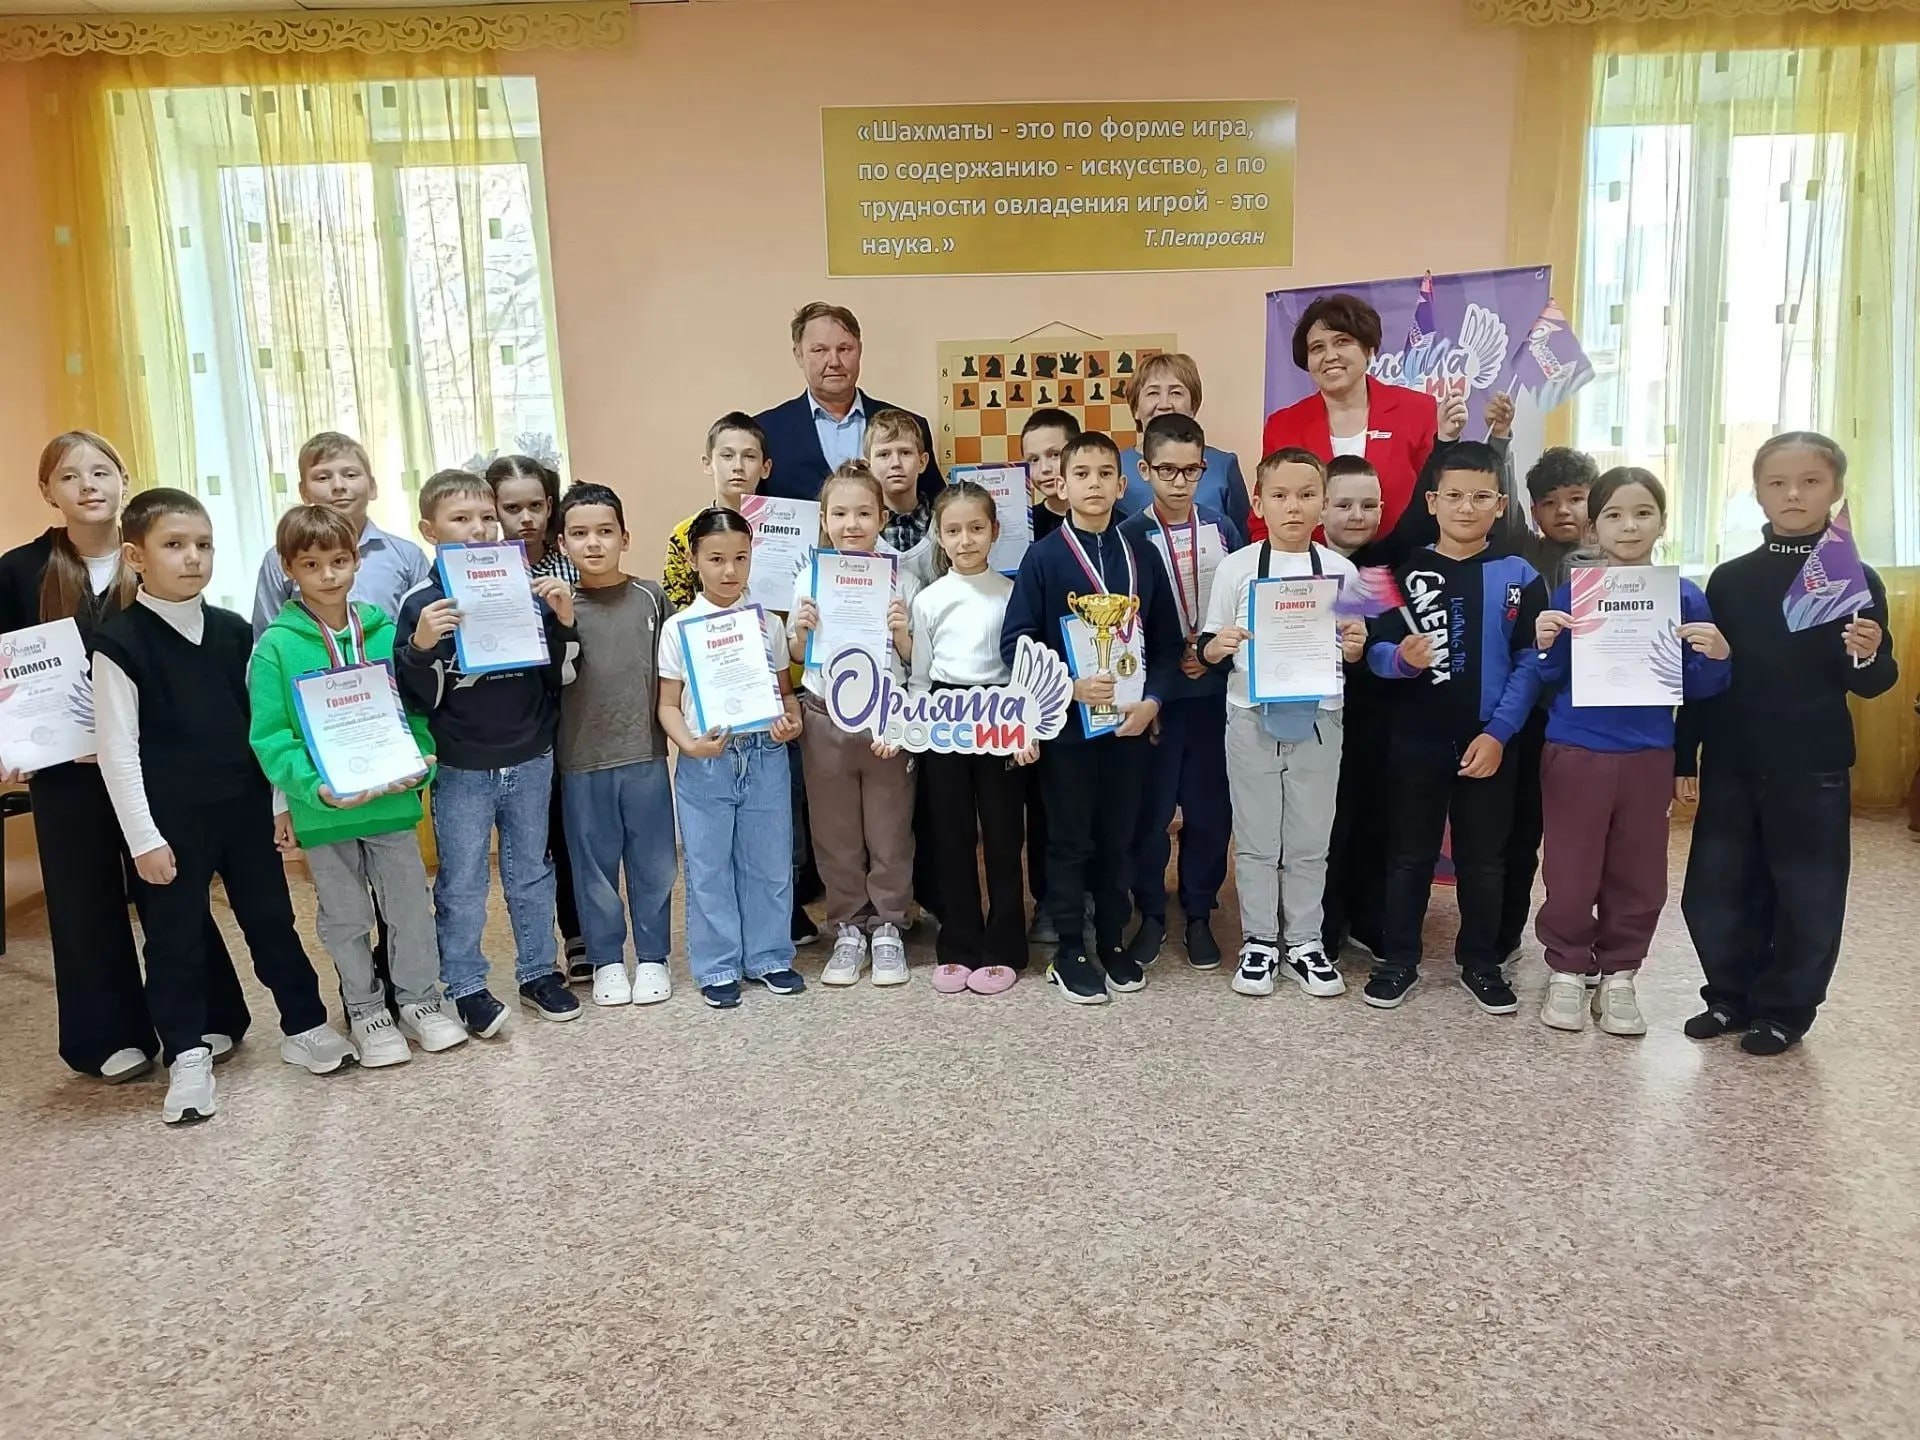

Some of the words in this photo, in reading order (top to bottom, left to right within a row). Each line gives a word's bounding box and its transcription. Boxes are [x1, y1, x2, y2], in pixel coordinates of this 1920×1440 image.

[857, 118, 993, 142] «Шахматы
[1015, 122, 1053, 140] это
[1062, 121, 1092, 138] по
[1100, 115, 1185, 142] форме
[1192, 117, 1254, 141] игра,
[858, 164, 888, 180] по
[894, 158, 1058, 184] содержанию
[1080, 157, 1208, 180] искусство,
[1214, 159, 1229, 174] а
[1236, 157, 1266, 174] по
[860, 198, 986, 222] трудности
[994, 192, 1129, 219] овладения
[1136, 189, 1209, 217] игрой
[1230, 192, 1269, 210] это
[1144, 228, 1265, 248] Т.Петросян
[862, 236, 955, 258] наука.»
[942, 368, 948, 378] 8
[943, 396, 949, 405] 7
[944, 423, 950, 432] 6
[945, 450, 951, 459] 5
[759, 522, 800, 536] Грамота
[466, 568, 507, 580] Грамота
[836, 575, 873, 586] Грамота
[1275, 600, 1316, 611] Грамота
[1597, 600, 1654, 612] Грамота
[707, 634, 744, 649] Грамота
[3, 656, 62, 680] Грамота
[829, 648, 1026, 736] Орлята
[326, 691, 371, 709] Грамота
[884, 722, 1025, 749] РОССИИ
